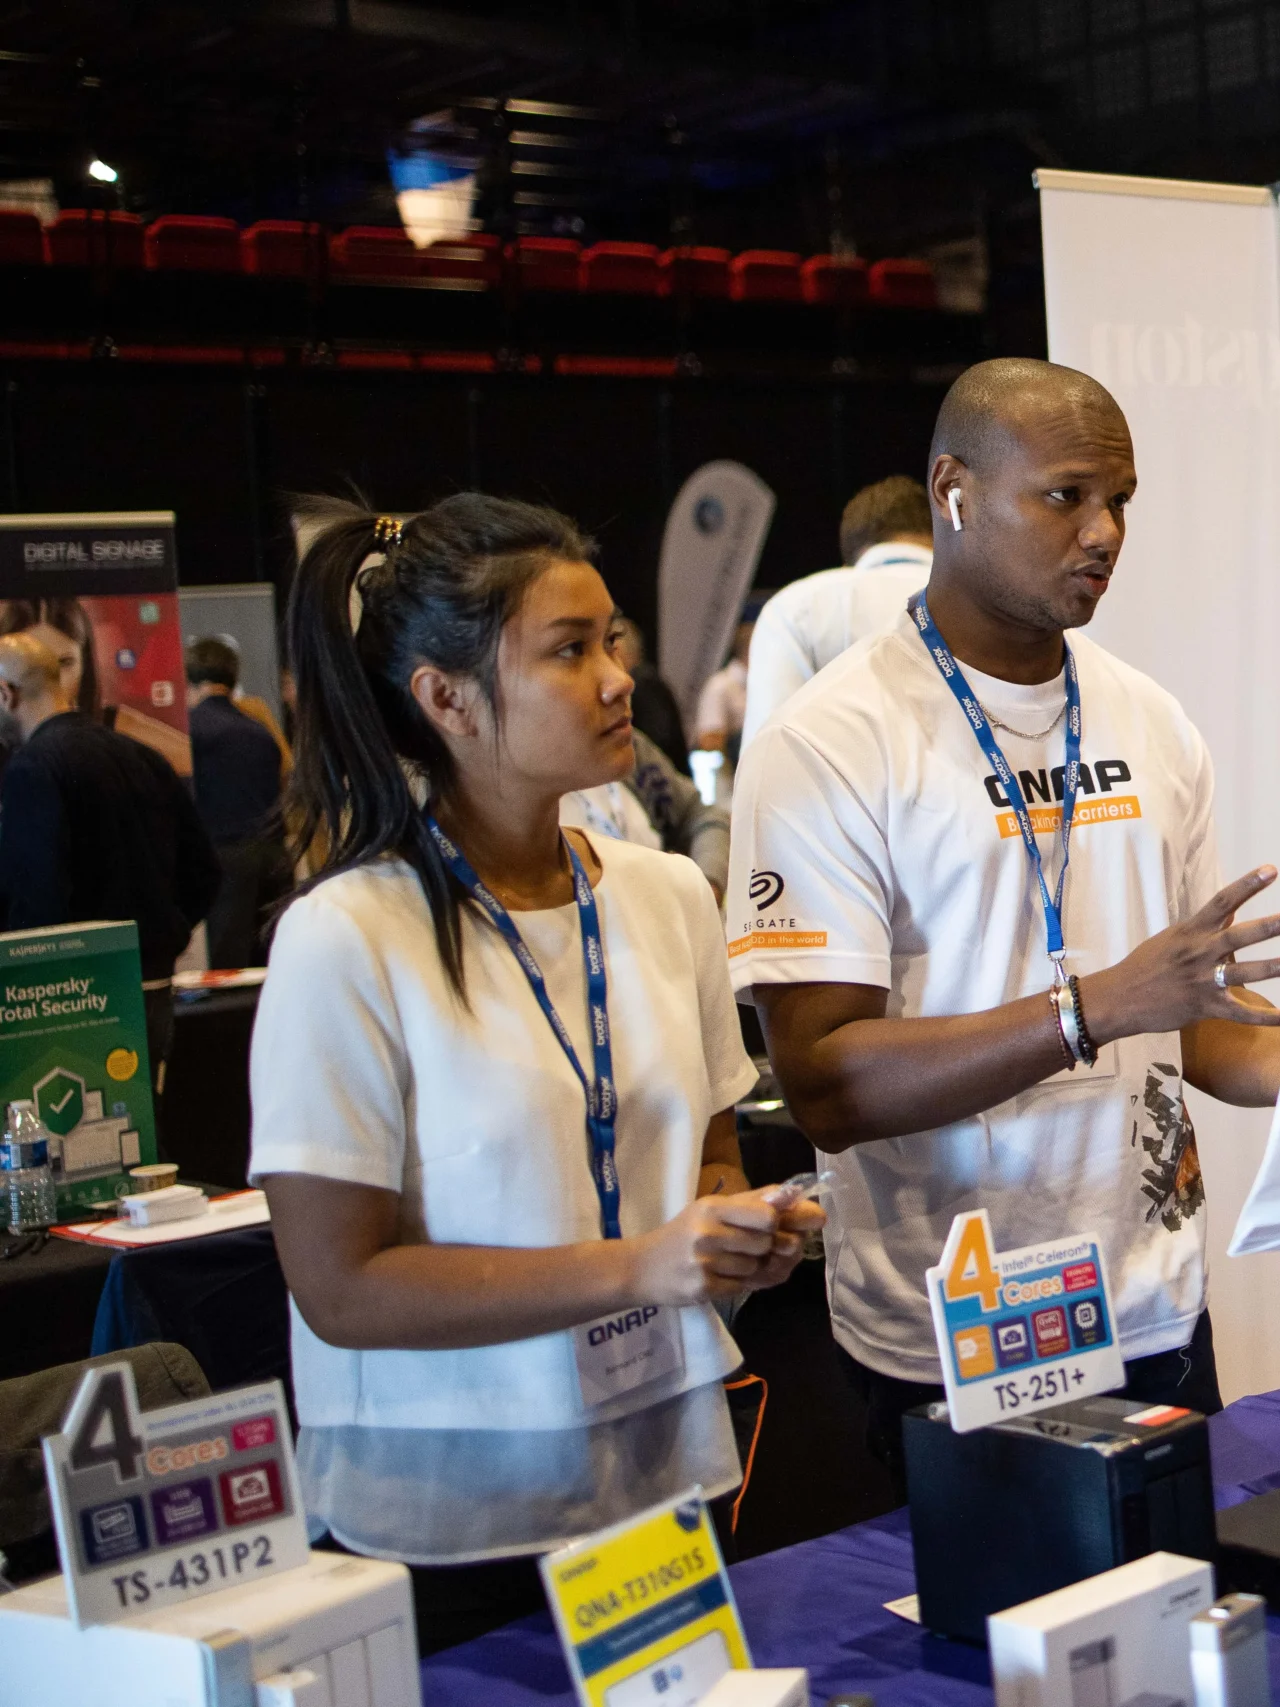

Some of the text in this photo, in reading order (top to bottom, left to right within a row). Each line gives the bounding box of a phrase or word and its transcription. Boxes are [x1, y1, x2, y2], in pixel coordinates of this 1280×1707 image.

[24, 542, 88, 563] DIGITAL
[933, 646, 954, 677] brother
[962, 696, 983, 729] brother
[990, 752, 1010, 785] brother
[1069, 761, 1079, 793] brother
[1018, 808, 1032, 844] brother
[587, 936, 601, 975] brother
[780, 936, 794, 944] the
[797, 936, 824, 944] world
[6, 977, 90, 1002] Kaspersky
[41, 994, 108, 1017] Security
[592, 1005, 606, 1046] brother
[1003, 1275, 1062, 1306] Cores
[587, 1305, 659, 1347] QNAP
[994, 1367, 1085, 1410] TS-251+
[147, 1436, 228, 1476] Cores
[112, 1536, 273, 1607] TS-431P2
